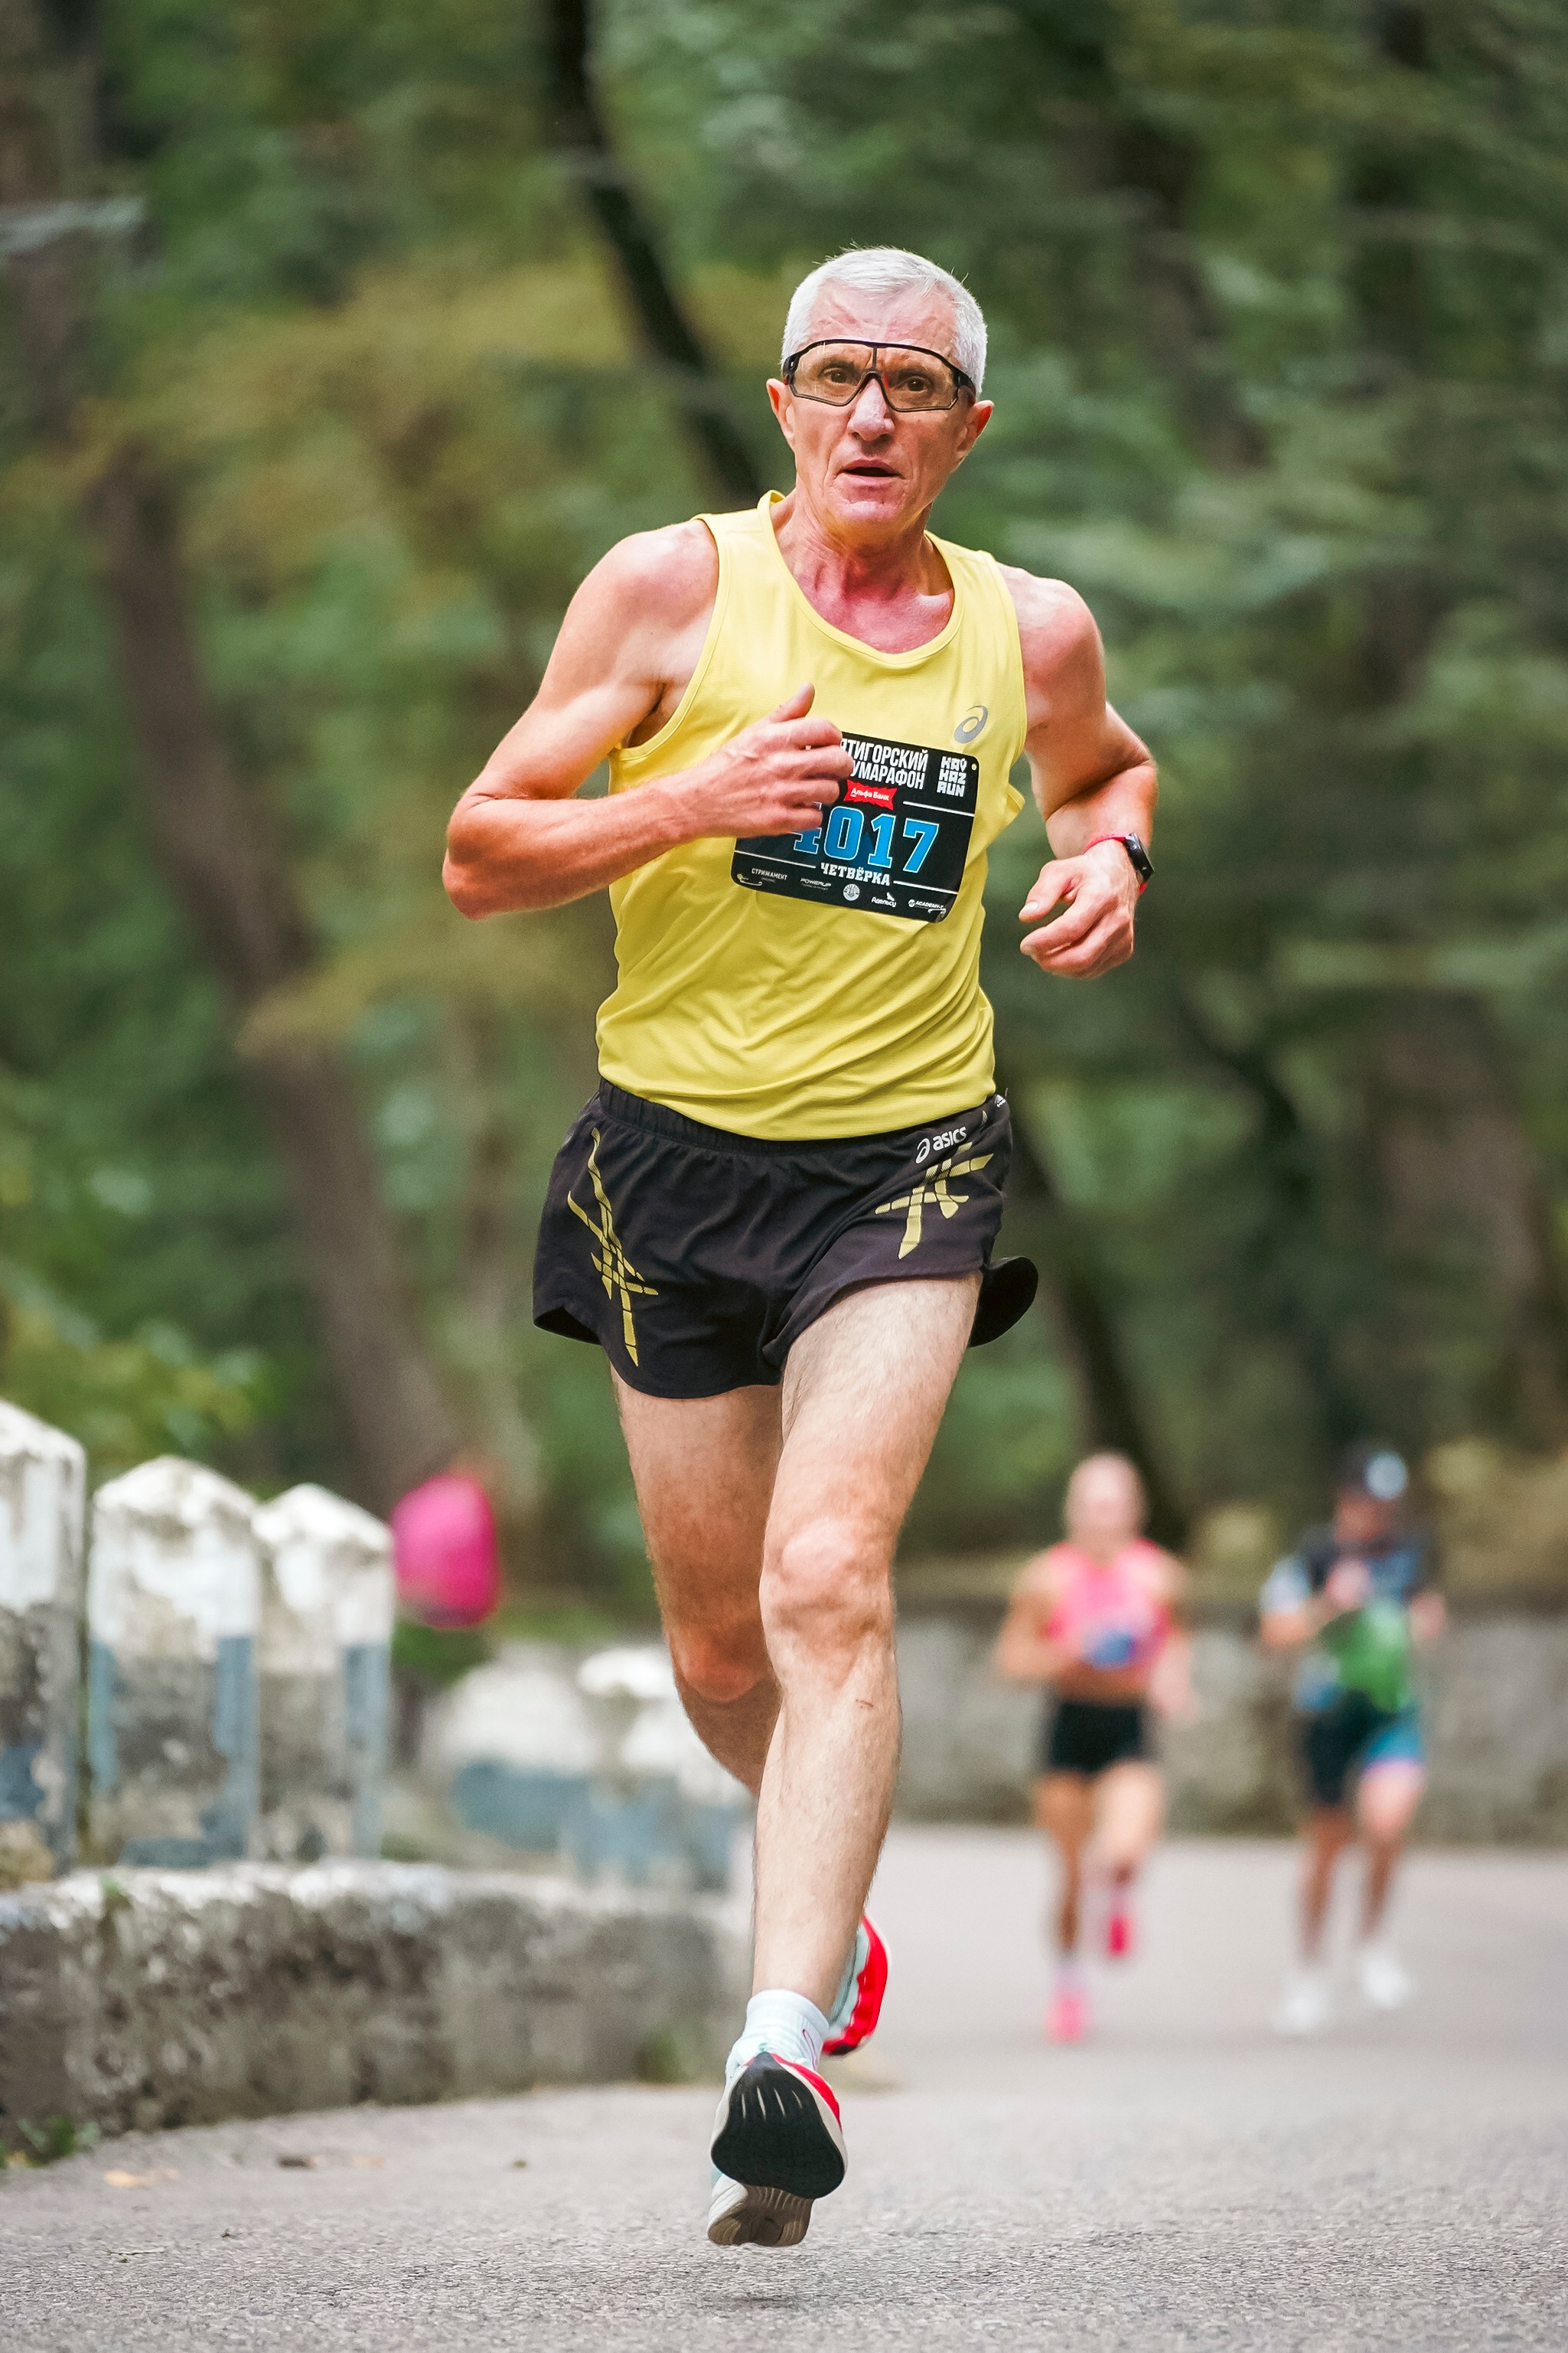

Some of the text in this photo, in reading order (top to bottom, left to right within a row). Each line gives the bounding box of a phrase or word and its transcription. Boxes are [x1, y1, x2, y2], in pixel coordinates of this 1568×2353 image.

[872, 791, 889, 801] Банк
[751, 868, 787, 880] СТРИЖАМЕНТ
[821, 863, 890, 886] ЧЕТВЁРКА
[933, 1126, 967, 1150] asics
